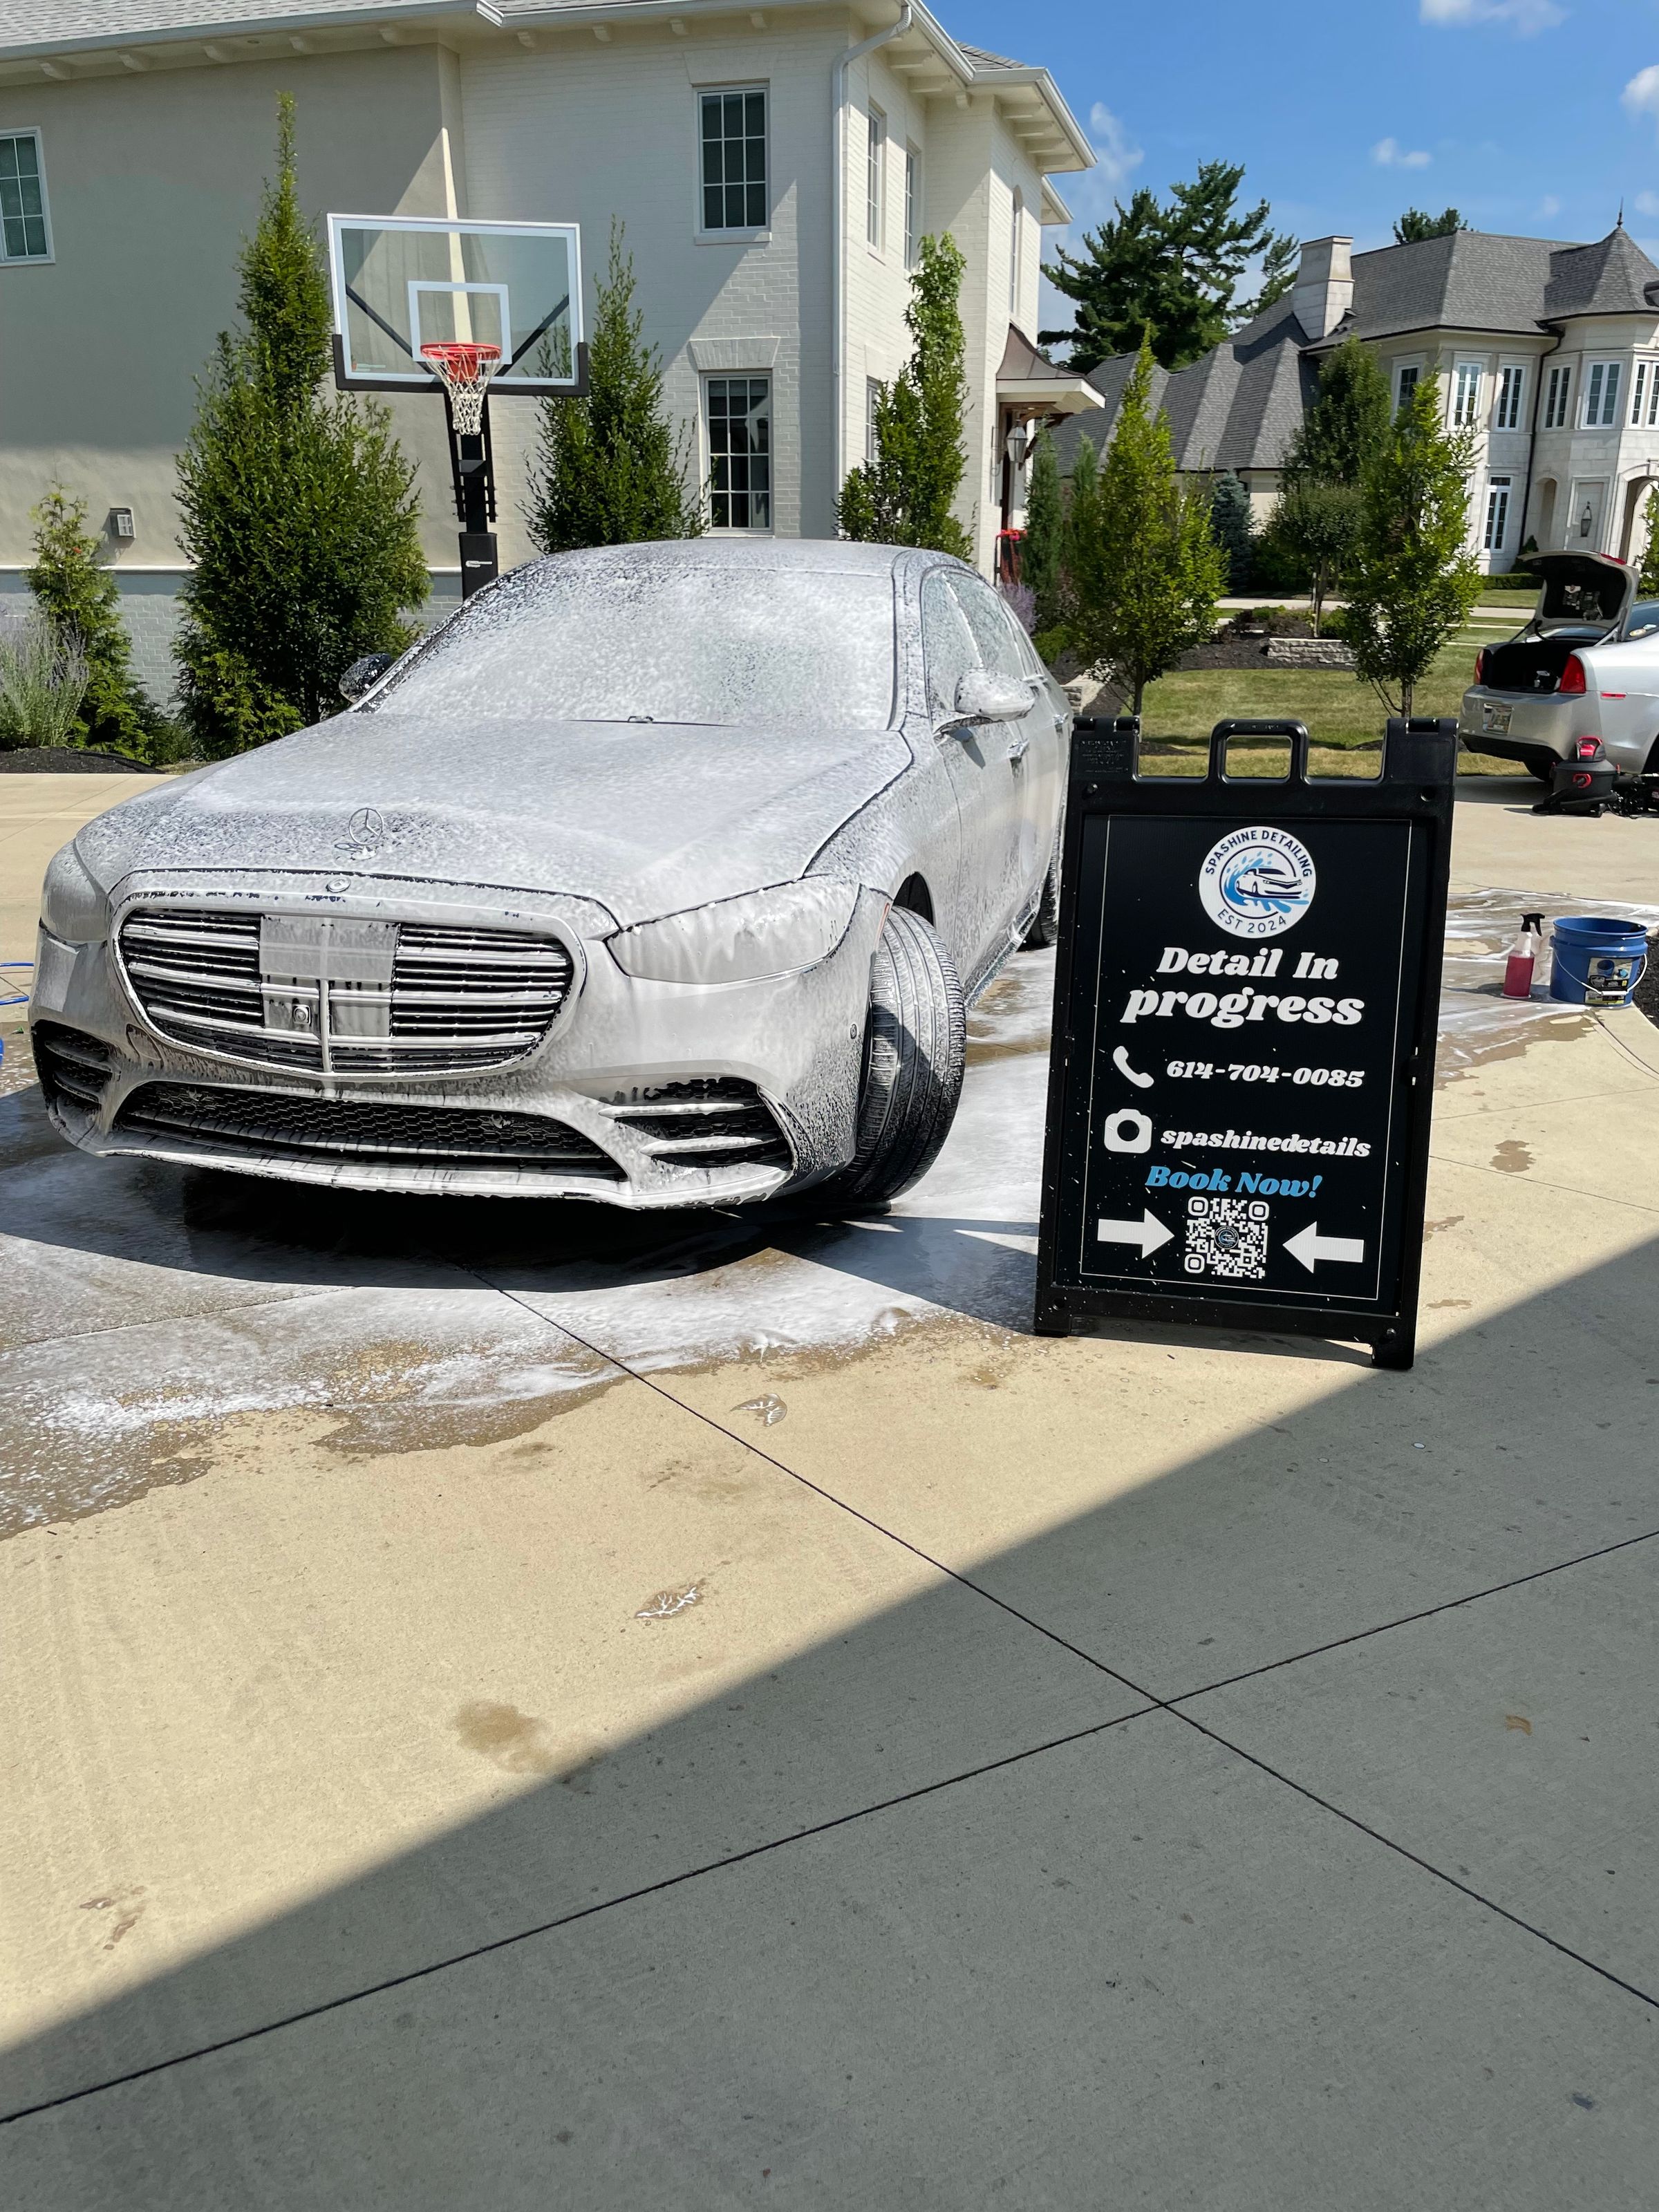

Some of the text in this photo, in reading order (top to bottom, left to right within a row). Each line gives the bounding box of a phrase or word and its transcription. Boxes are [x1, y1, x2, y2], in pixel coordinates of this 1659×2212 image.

[1206, 830, 1312, 878] SPASHINE DETAILING
[1217, 908, 1287, 933] EST 2024
[1156, 946, 1339, 980] Detail In
[1119, 986, 1365, 1029] progress
[1166, 1060, 1365, 1088] 614-704-0085
[1160, 1130, 1371, 1157] spashinedetails
[1145, 1165, 1323, 1198] Book Now!
